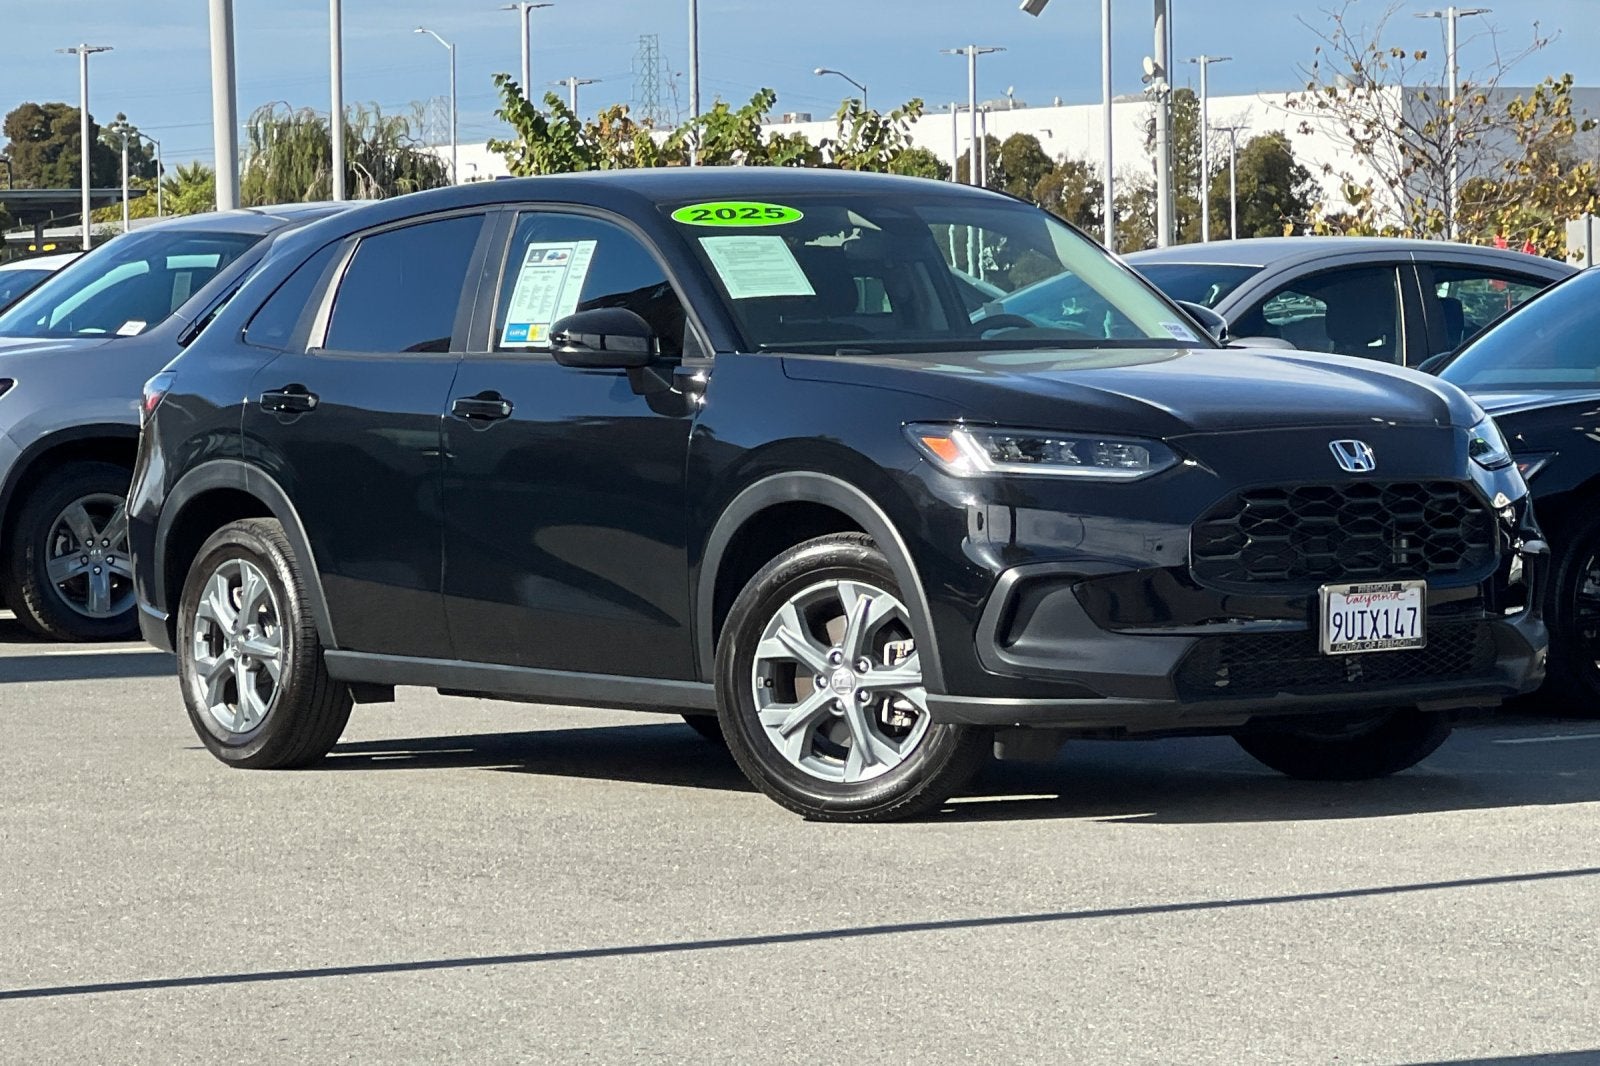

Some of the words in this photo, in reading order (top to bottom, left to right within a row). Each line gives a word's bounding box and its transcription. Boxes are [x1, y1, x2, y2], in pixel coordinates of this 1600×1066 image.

[690, 207, 786, 221] 2025
[1345, 592, 1405, 607] California
[1332, 607, 1417, 642] 9UIX147
[1335, 641, 1362, 652] ACURA
[1364, 640, 1376, 649] OF
